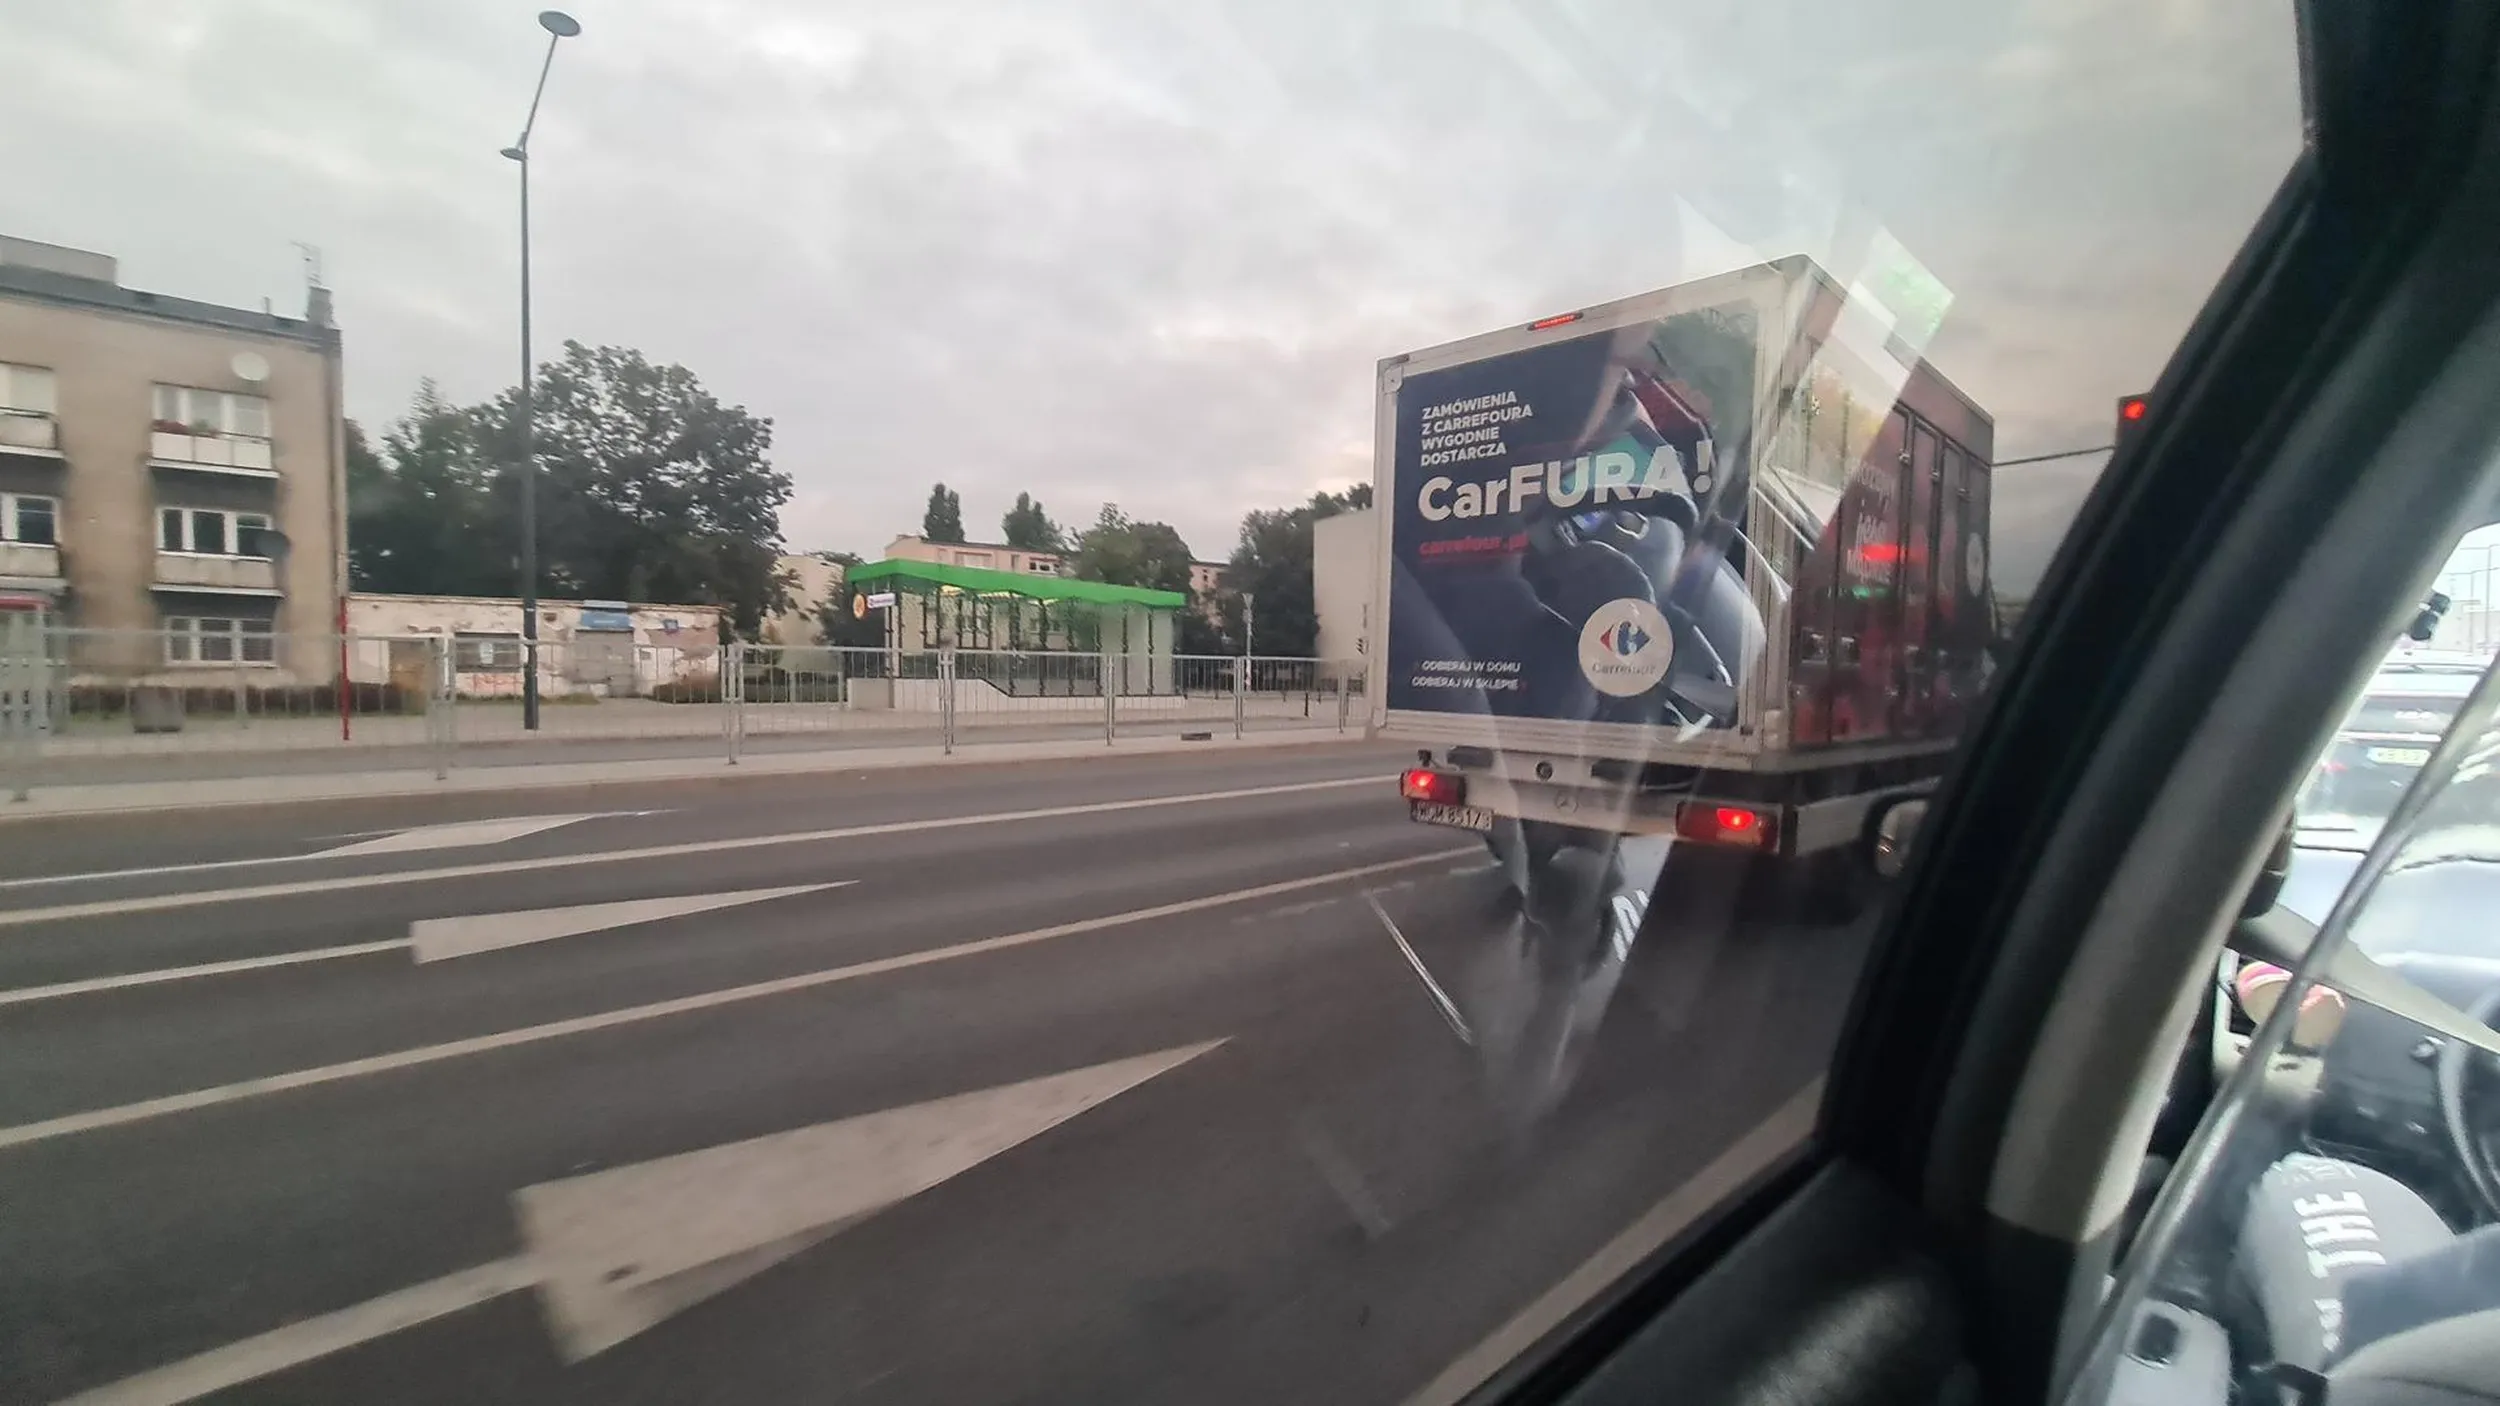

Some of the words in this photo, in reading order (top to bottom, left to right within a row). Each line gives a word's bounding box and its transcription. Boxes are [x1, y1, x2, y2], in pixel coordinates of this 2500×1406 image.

[1422, 391, 1517, 420] ZAMÓWIENIA
[1422, 423, 1431, 435] Z
[1434, 404, 1533, 433] CARREFOURA
[1422, 427, 1500, 451] WYGODNIE
[1421, 442, 1506, 466] DOSTARCZA
[1418, 440, 1713, 521] CarFURA!
[1487, 661, 1521, 673] DOMU
[2293, 1191, 2386, 1279] THE
